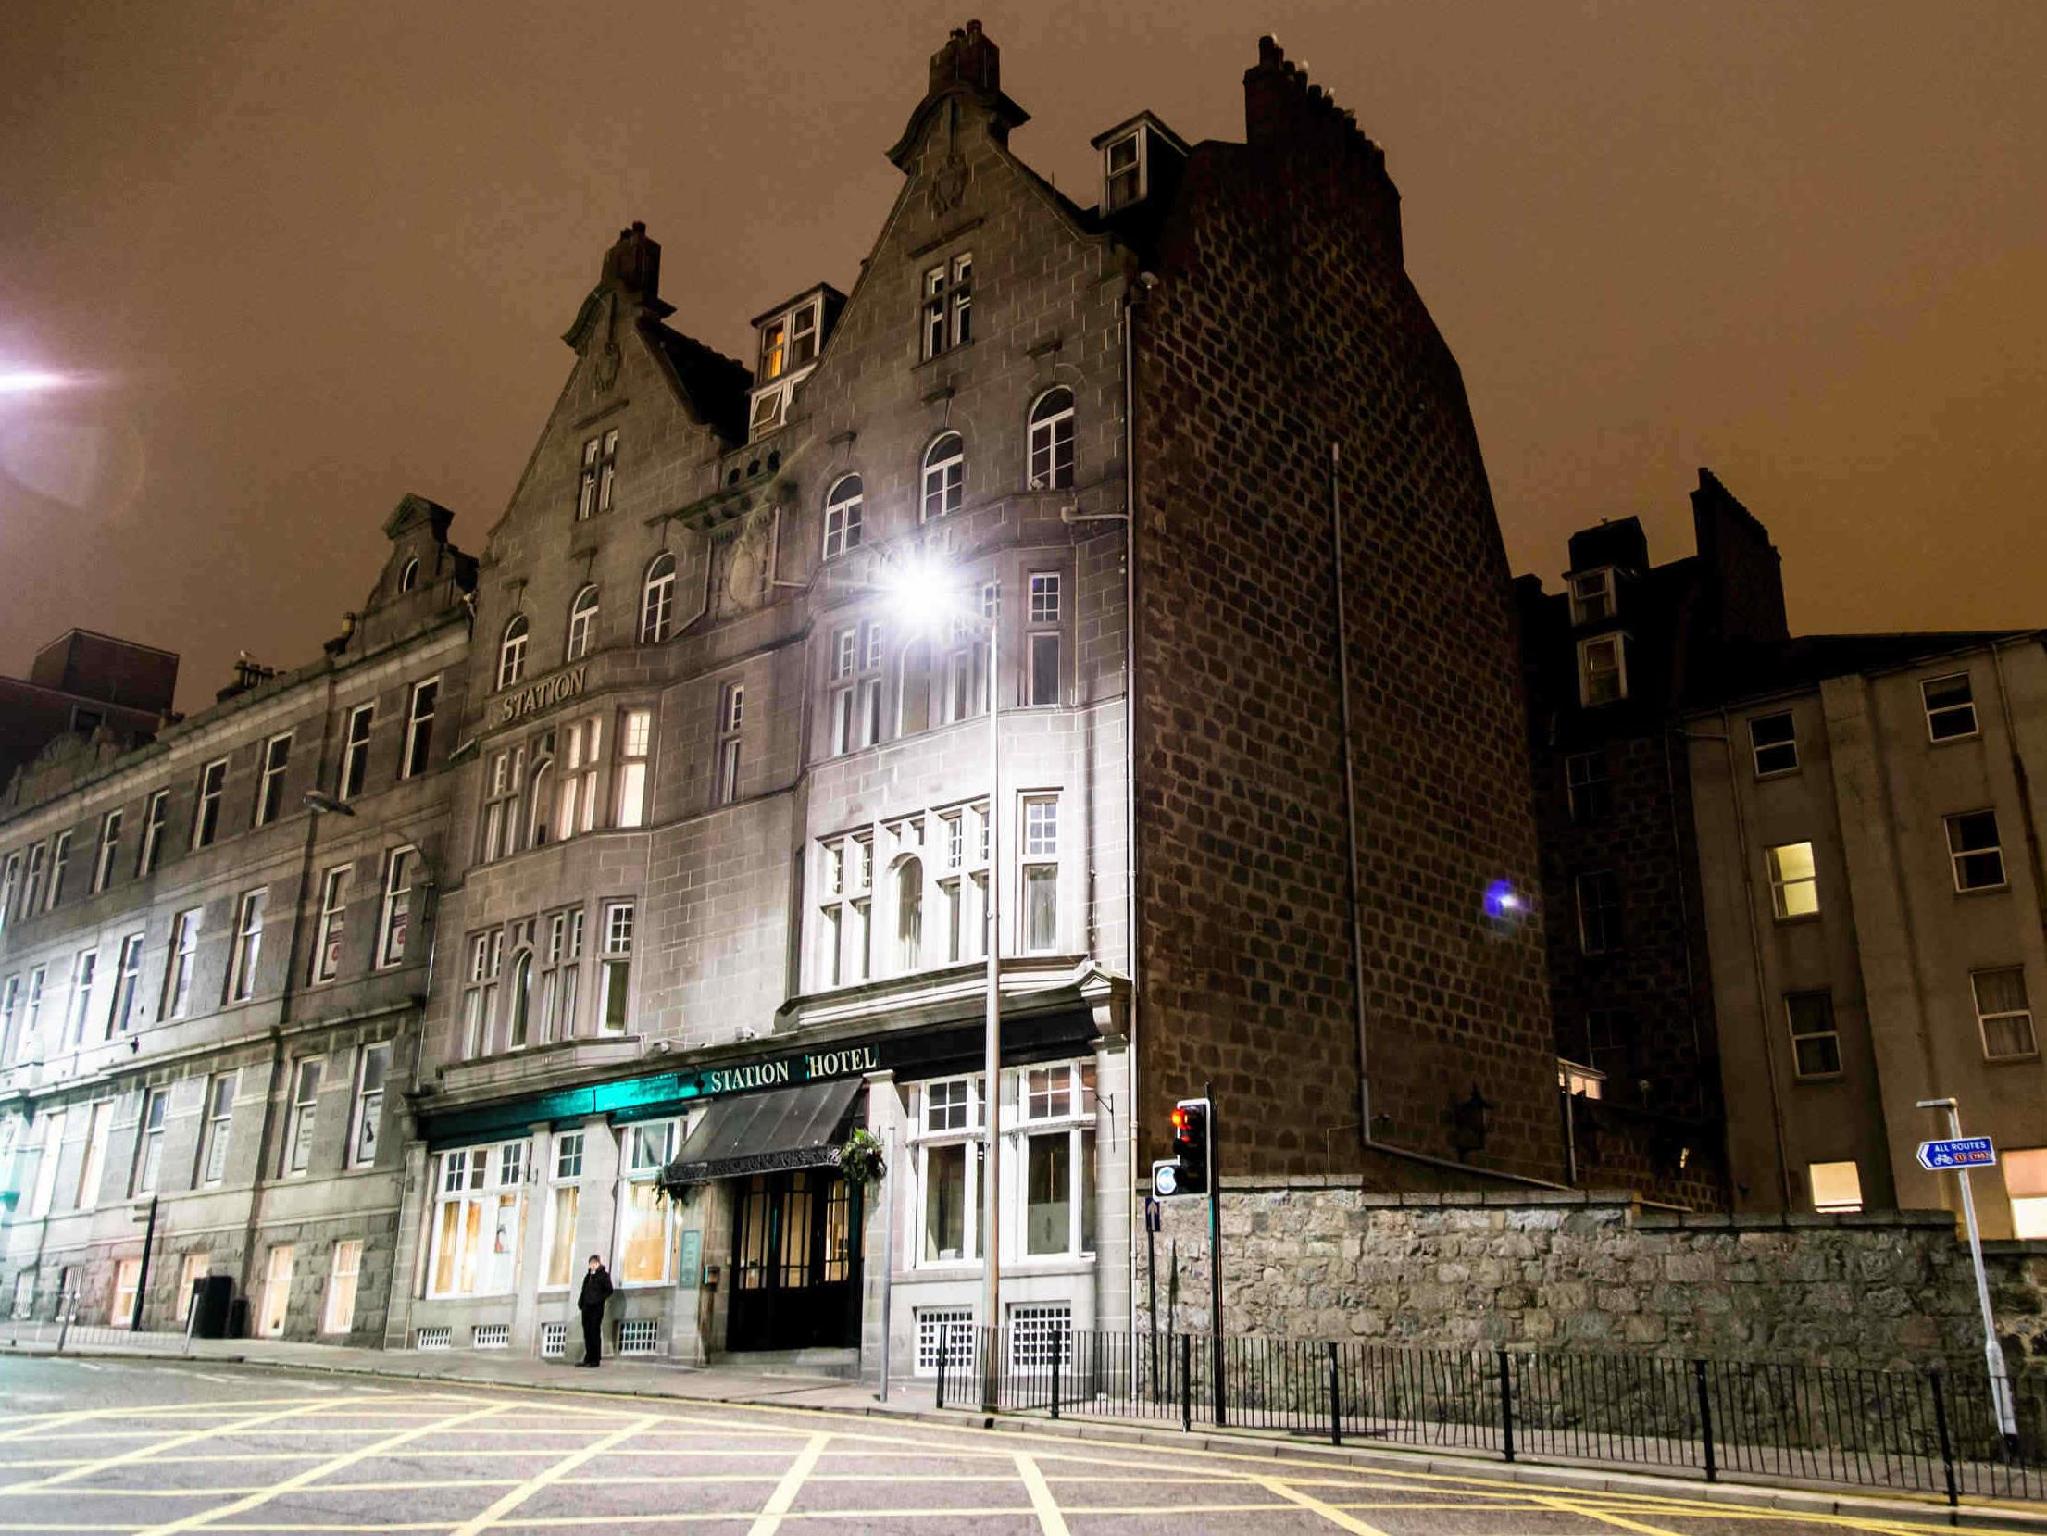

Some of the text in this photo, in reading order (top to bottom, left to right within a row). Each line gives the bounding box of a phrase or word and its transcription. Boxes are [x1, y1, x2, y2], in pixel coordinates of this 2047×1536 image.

[502, 667, 588, 721] STATION
[711, 1047, 877, 1093] STATION HOTEL
[1935, 1141, 1986, 1152] ALL ROUTES
